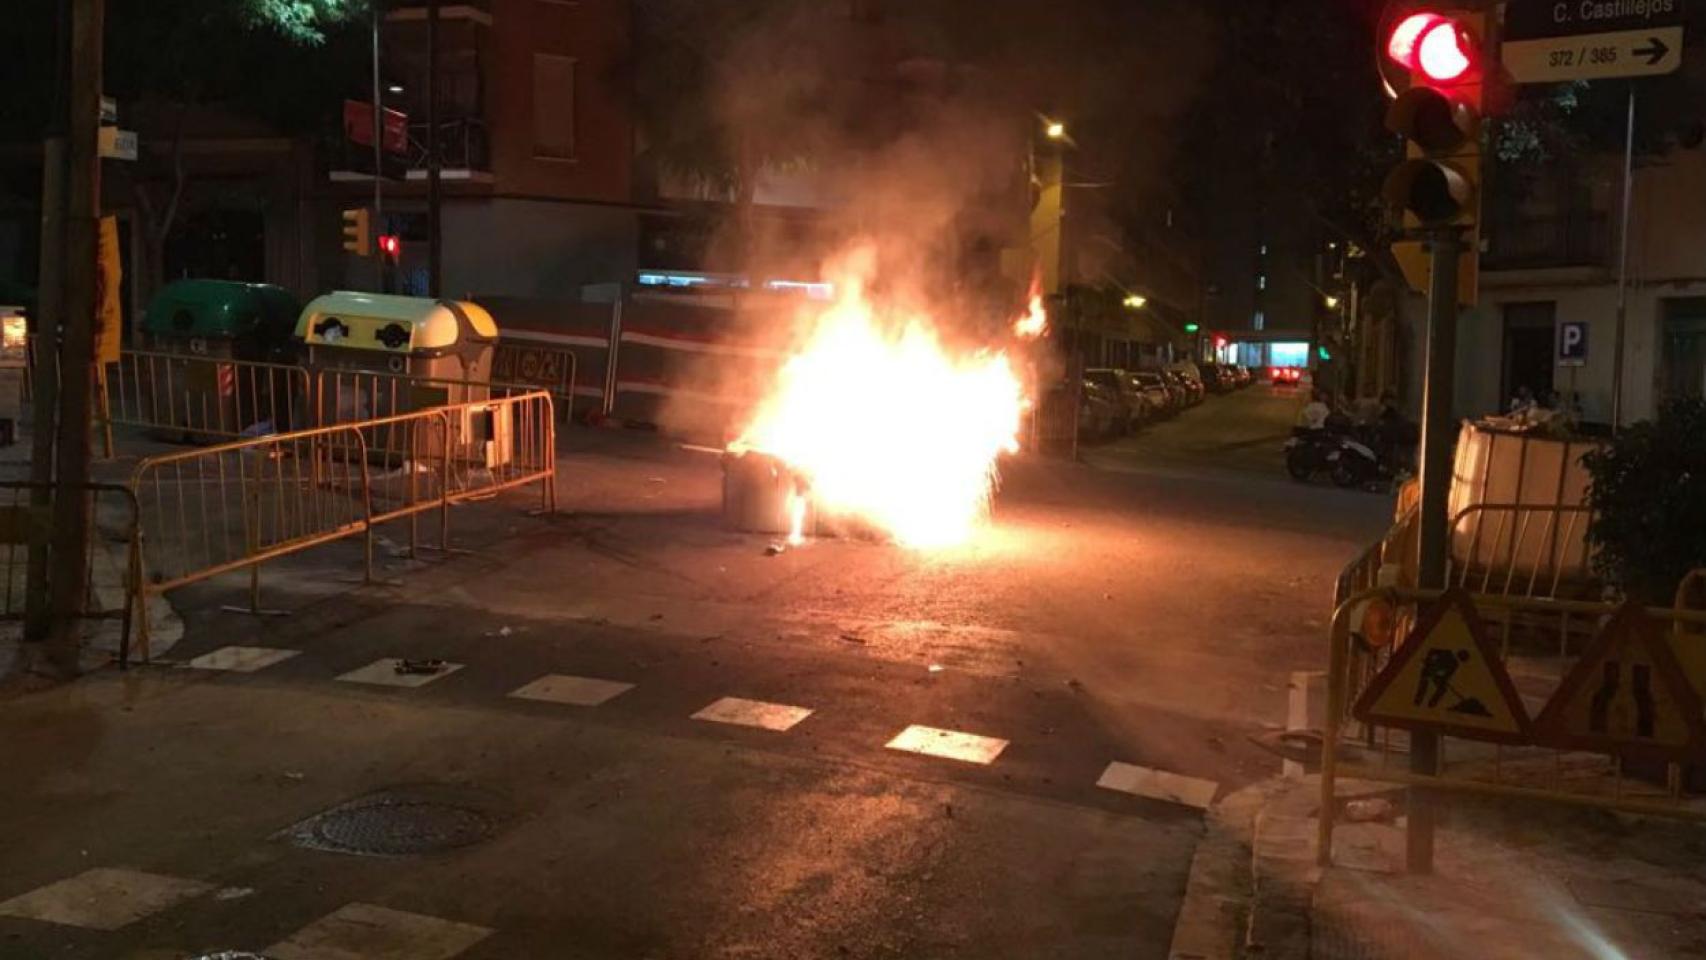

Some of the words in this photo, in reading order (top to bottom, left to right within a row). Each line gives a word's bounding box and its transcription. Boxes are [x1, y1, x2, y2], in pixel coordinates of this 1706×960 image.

[1553, 3, 1572, 22] C.
[1580, 0, 1673, 20] Castillejos
[1549, 50, 1573, 67] 372
[1578, 46, 1587, 66] /
[1563, 325, 1581, 355] P
